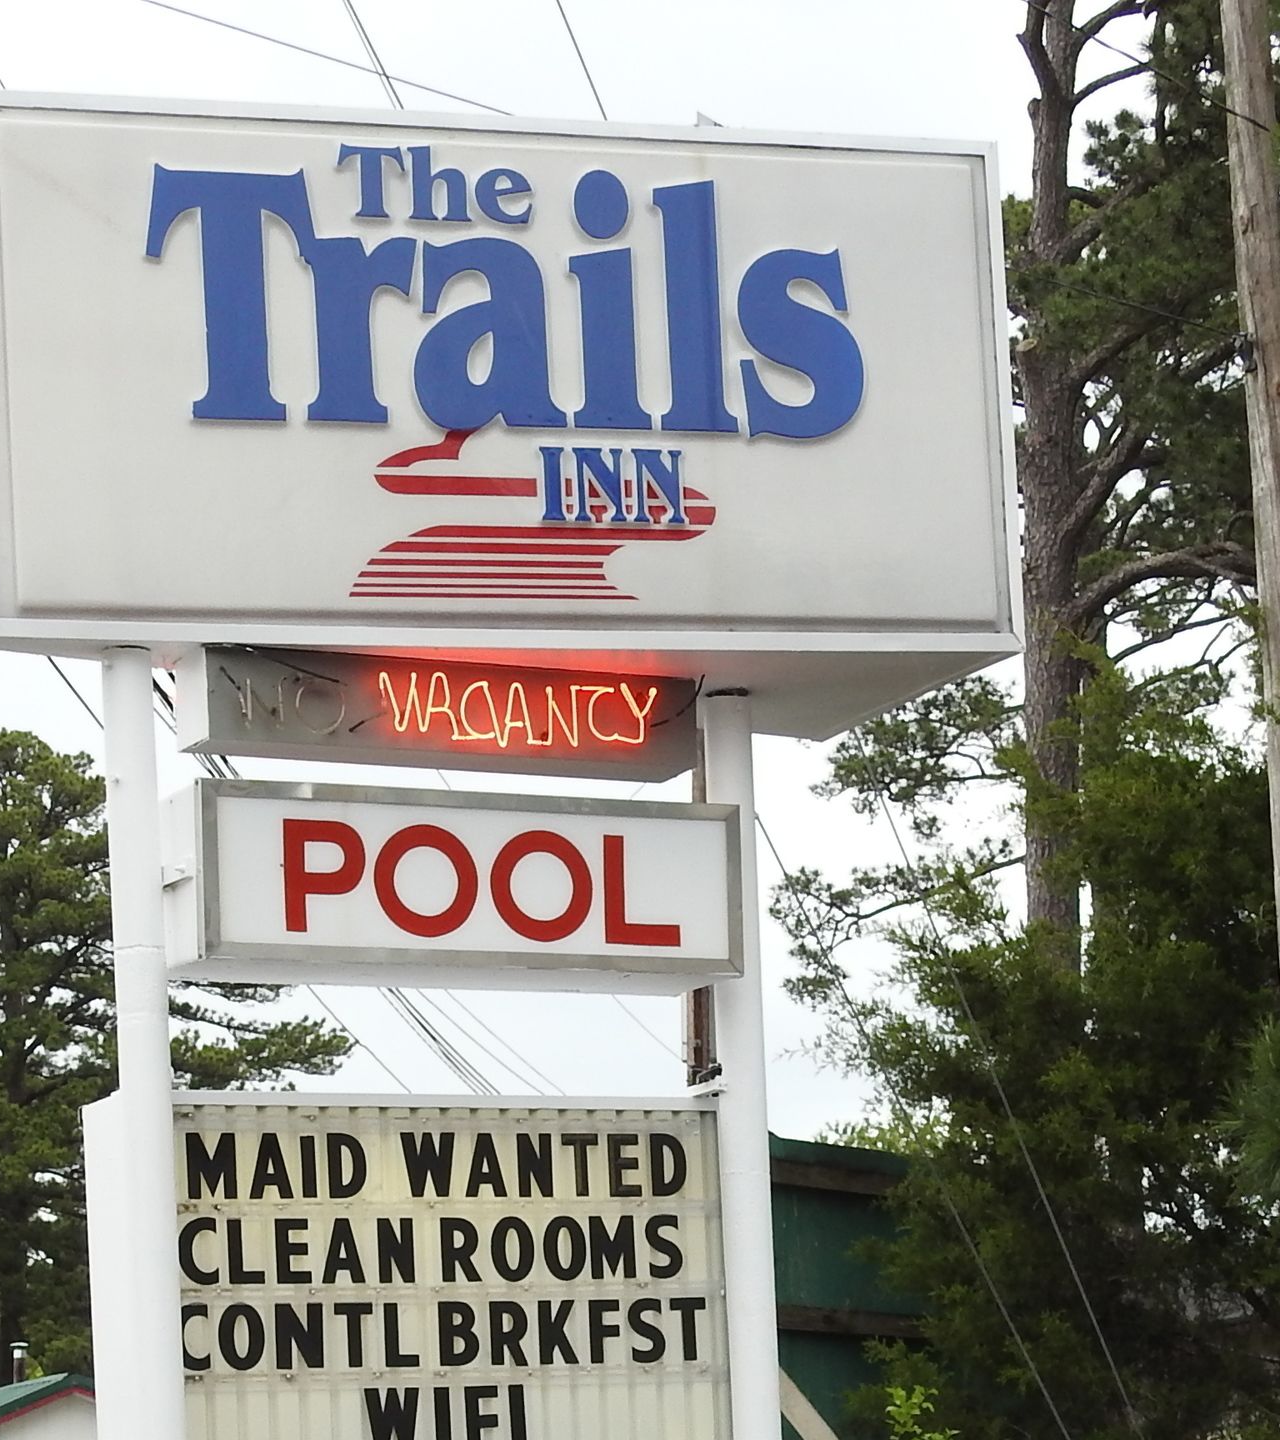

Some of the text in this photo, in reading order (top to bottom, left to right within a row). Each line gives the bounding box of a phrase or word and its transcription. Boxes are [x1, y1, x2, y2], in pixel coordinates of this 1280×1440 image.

[336, 142, 533, 226] The
[145, 162, 866, 440] Trails
[538, 446, 689, 526] INN
[378, 670, 659, 748] VACANCY
[282, 818, 681, 948] POOL
[184, 1131, 688, 1200] MAID WANTED
[178, 1213, 684, 1285] CLEAN ROOMS
[180, 1296, 707, 1371] CONTL BRKFST
